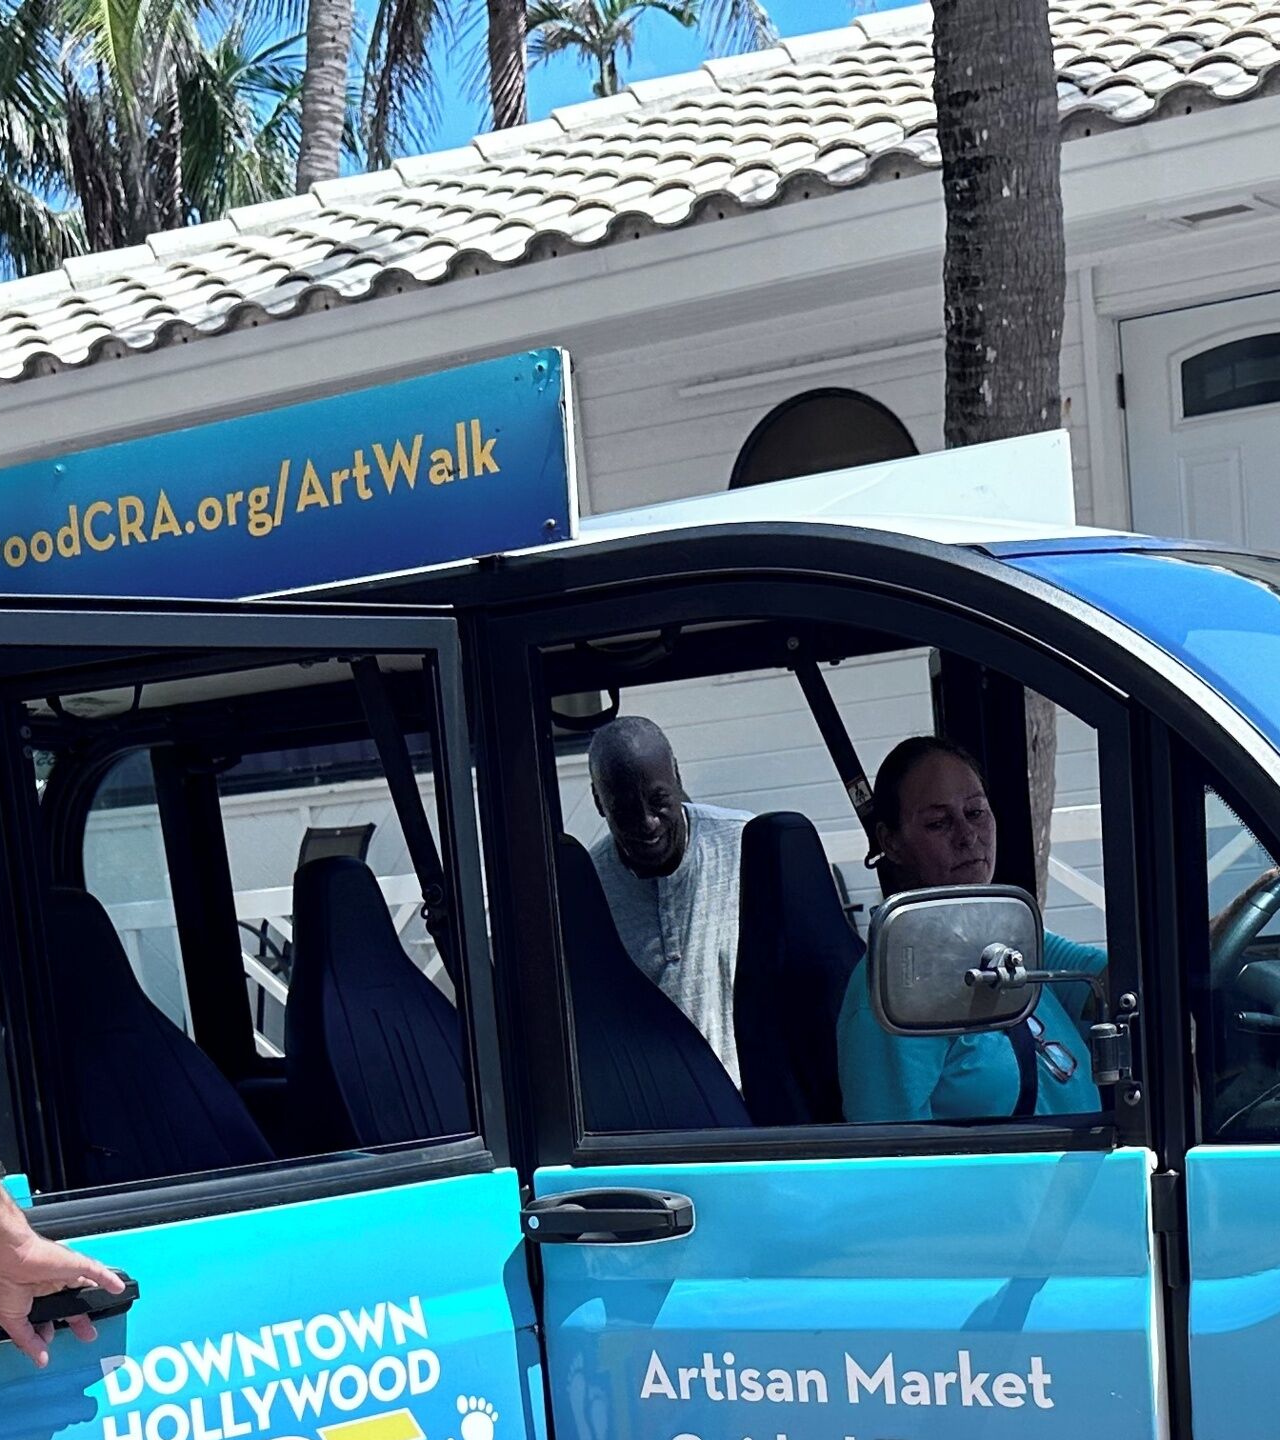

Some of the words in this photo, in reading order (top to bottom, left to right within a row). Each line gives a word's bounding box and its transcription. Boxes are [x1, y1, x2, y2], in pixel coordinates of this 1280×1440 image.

[102, 1295, 428, 1407] DOWNTOWN
[640, 1349, 829, 1403] Artisan
[845, 1351, 1055, 1409] Market
